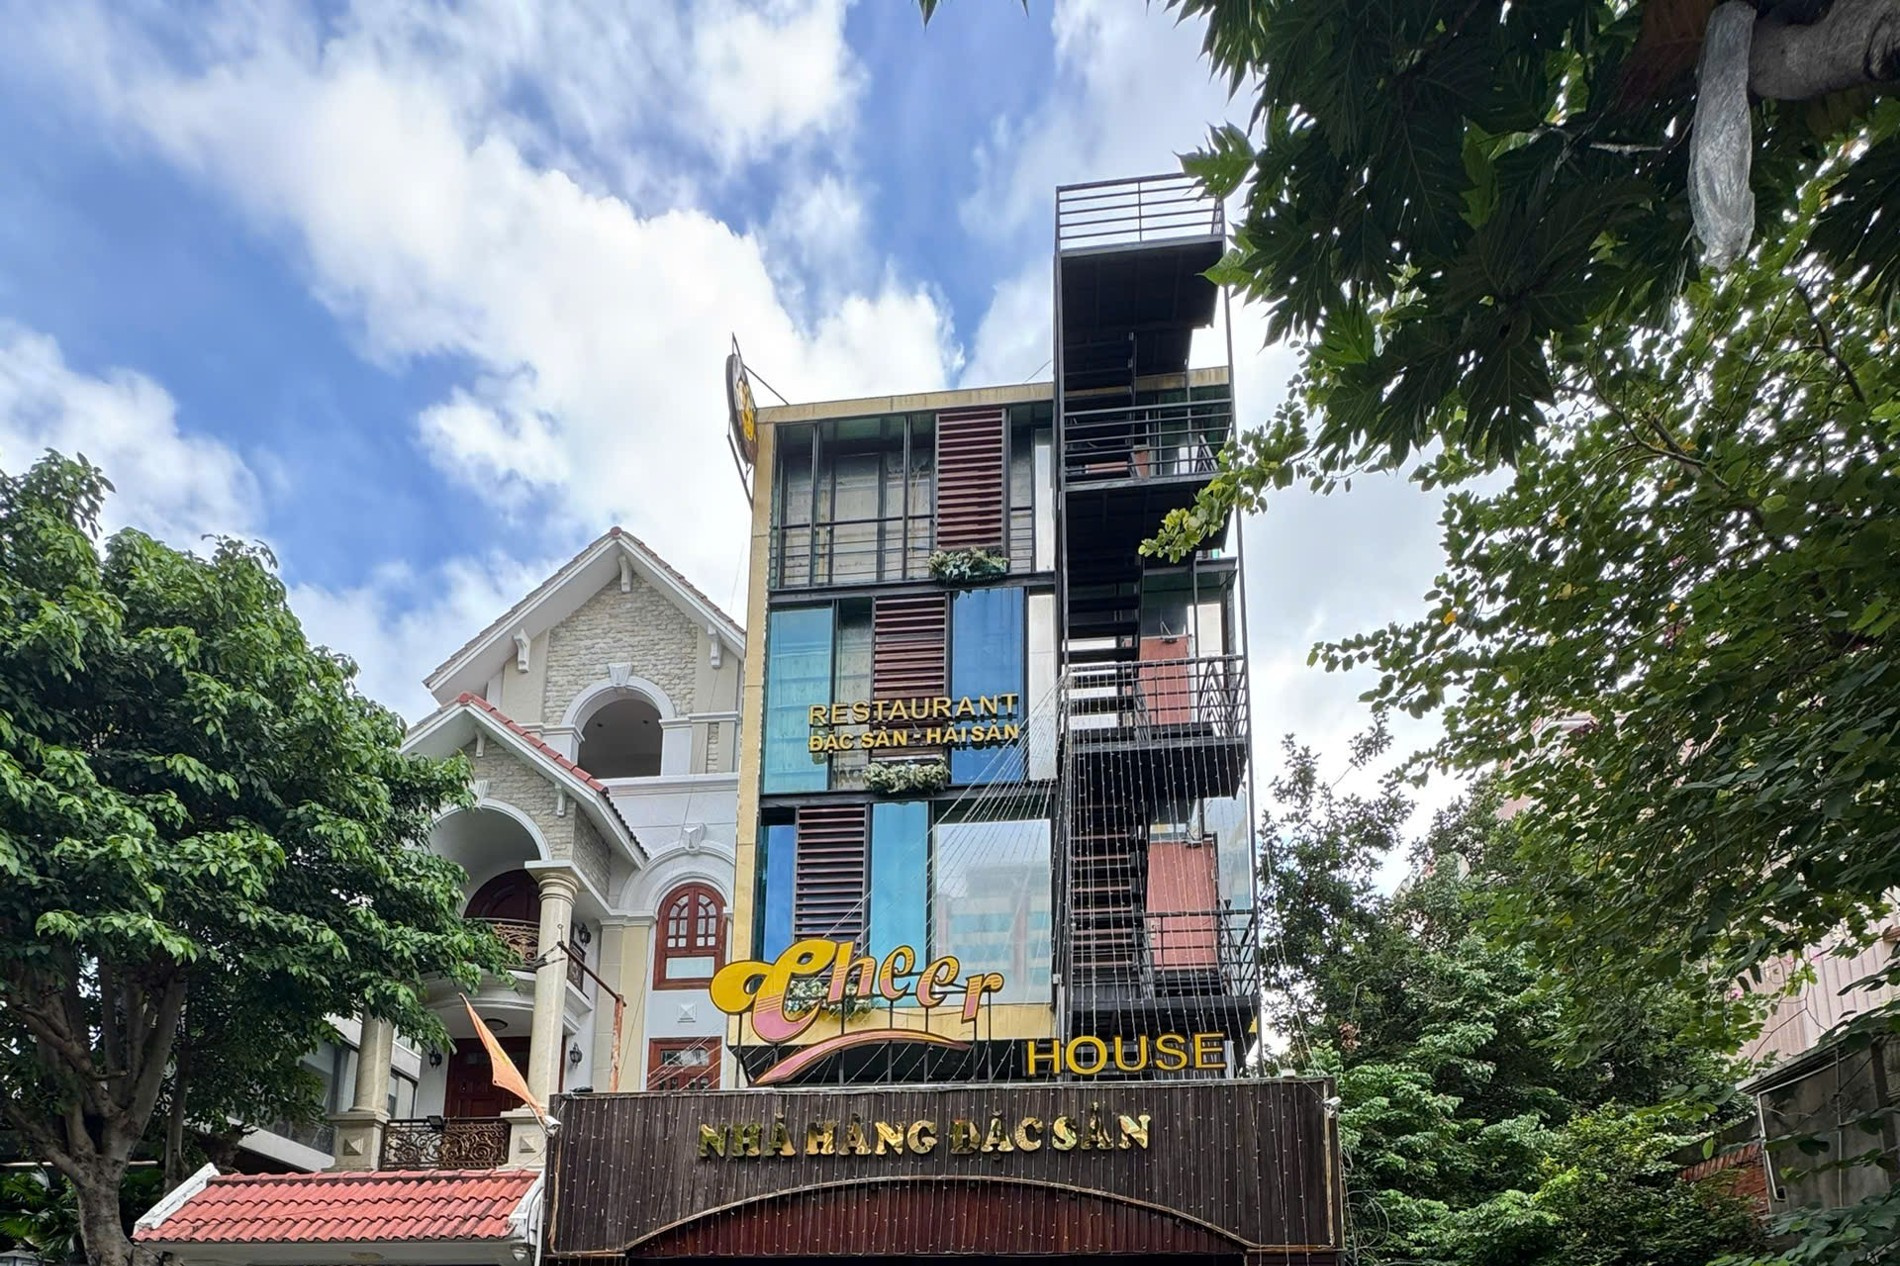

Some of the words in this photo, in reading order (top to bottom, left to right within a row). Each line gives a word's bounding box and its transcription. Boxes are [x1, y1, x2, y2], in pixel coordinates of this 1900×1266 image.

[809, 693, 1019, 724] RESTAURANT
[809, 729, 854, 753] ĐẶC
[861, 726, 908, 748] SẢN
[926, 722, 967, 745] HẢI
[971, 718, 1019, 742] SẢN
[709, 939, 1004, 1043] Cheer
[1027, 1032, 1228, 1077] HOUSE
